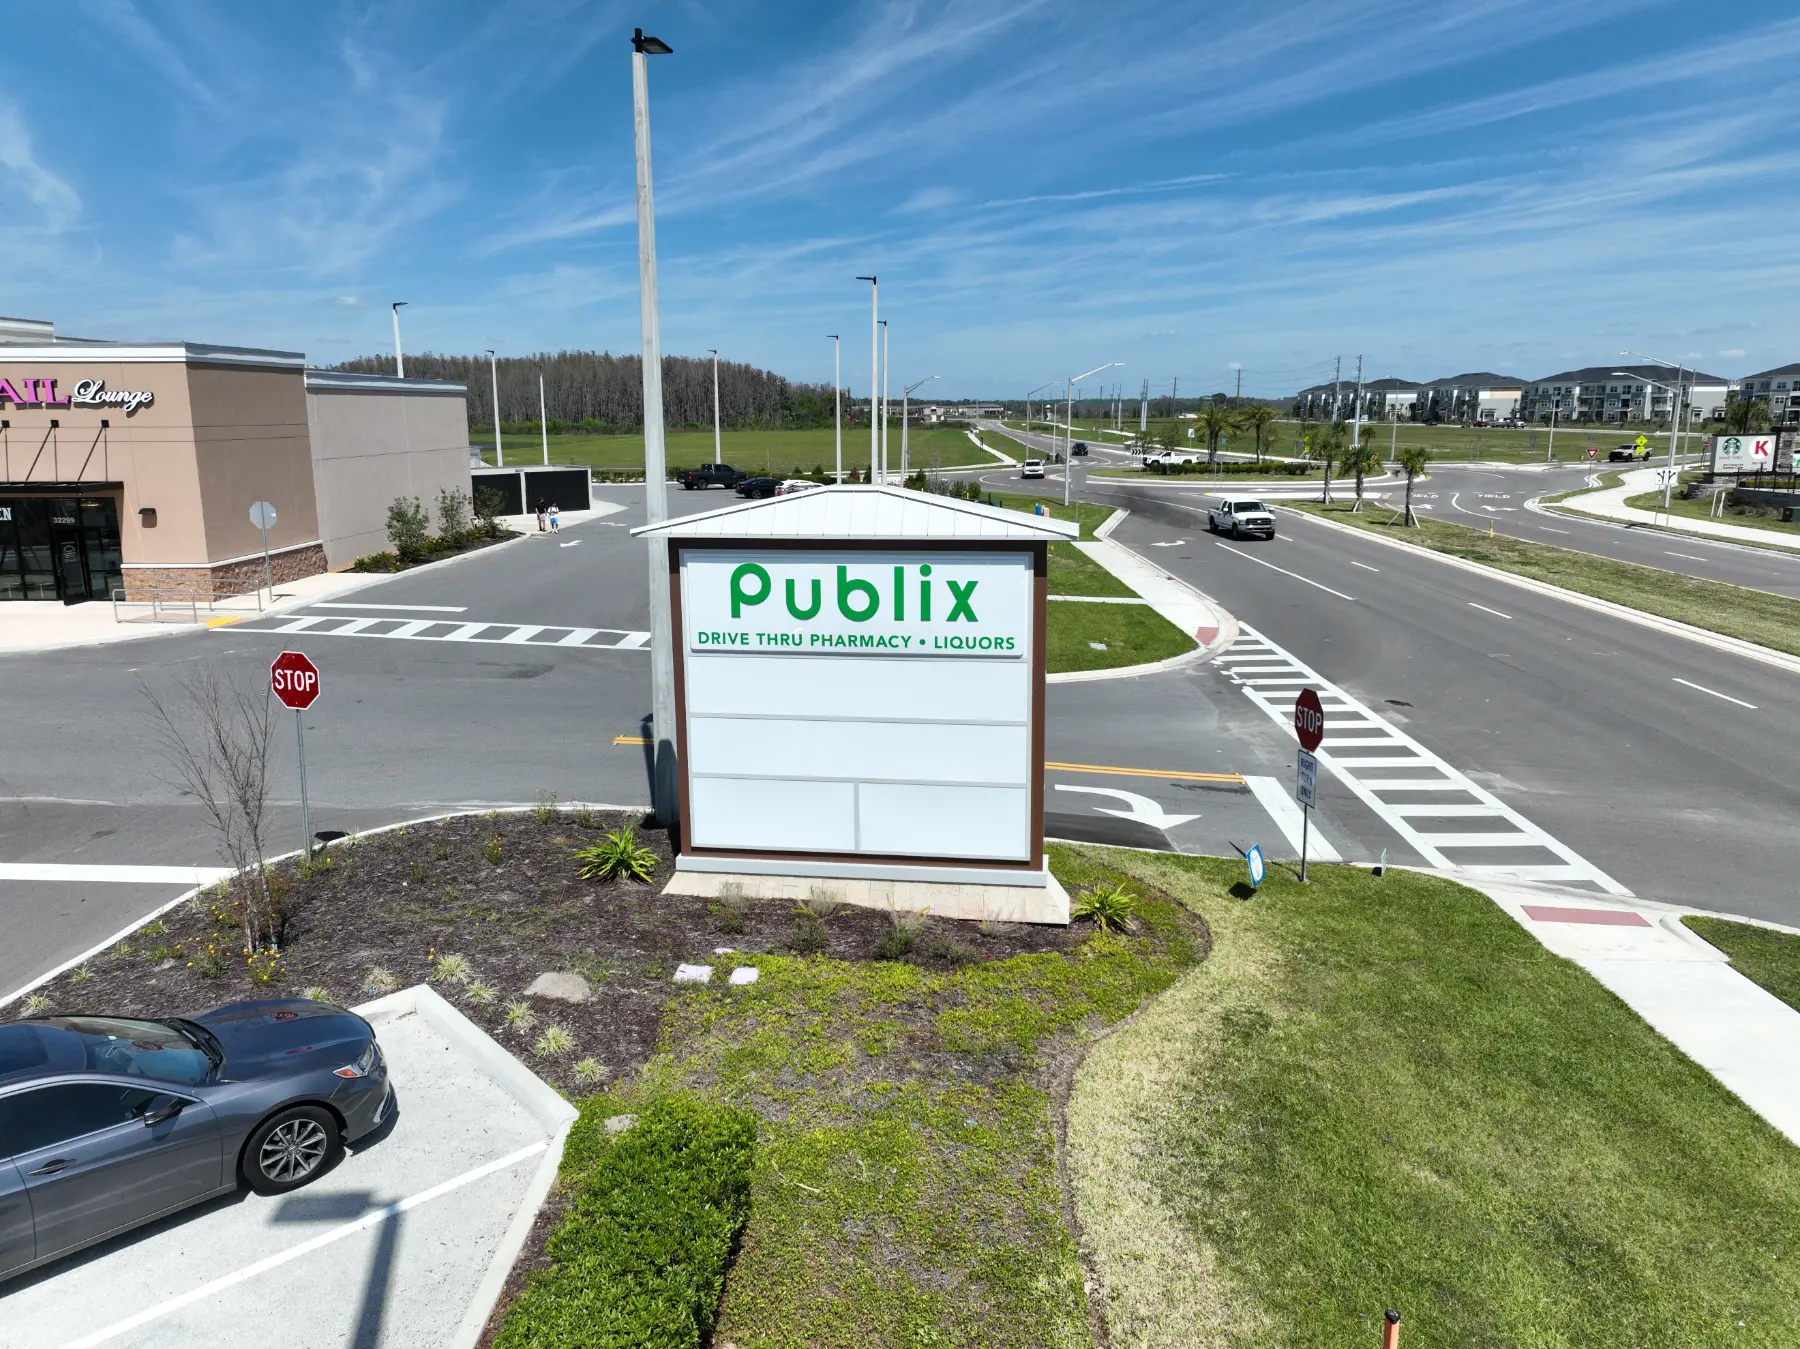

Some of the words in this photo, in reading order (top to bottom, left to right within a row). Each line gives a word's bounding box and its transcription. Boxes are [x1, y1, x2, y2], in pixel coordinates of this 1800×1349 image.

[72, 379, 153, 412] Lounge
[1755, 440, 1769, 457] K
[52, 516, 75, 524] 32299
[730, 562, 979, 622] Publix
[697, 631, 750, 646] DRIVE
[756, 632, 803, 647] THRU
[810, 634, 912, 649] PHARMACY
[933, 635, 1016, 650] LIQUORS
[275, 668, 316, 692] STOP
[1296, 705, 1322, 735] STOP
